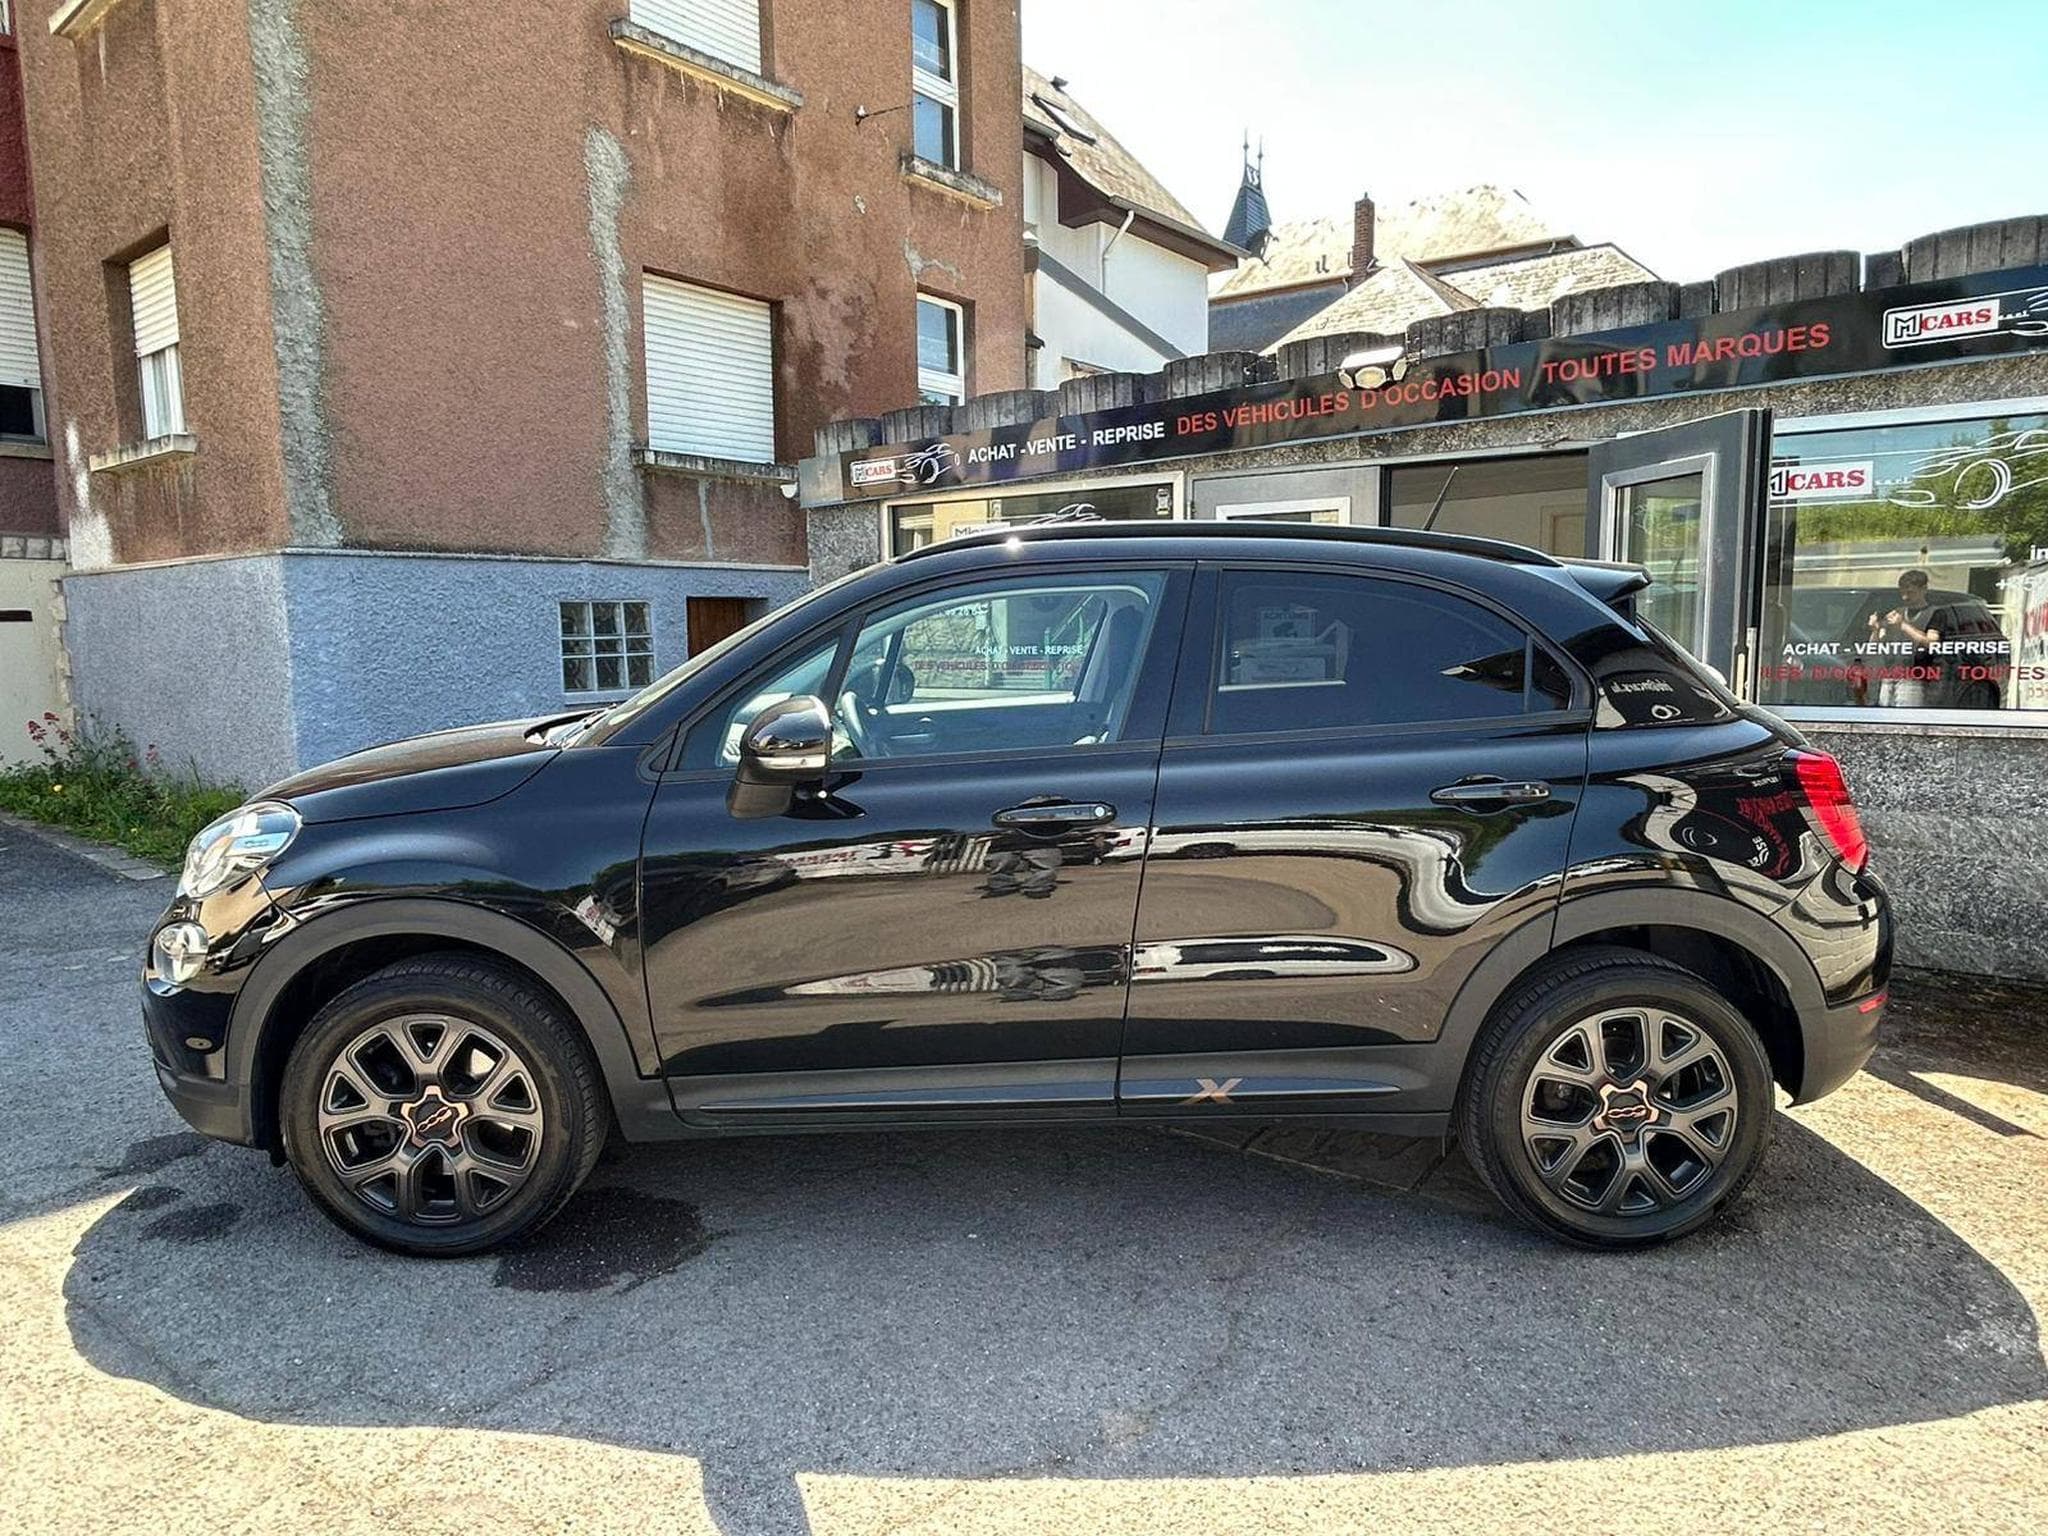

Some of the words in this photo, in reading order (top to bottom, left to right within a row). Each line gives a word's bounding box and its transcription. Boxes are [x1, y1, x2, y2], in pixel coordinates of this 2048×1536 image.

[968, 445, 1017, 465] ACHAT
[1027, 435, 1076, 456] VENTE
[1093, 422, 1166, 446] REPRISE
[1177, 410, 1218, 436] DES
[1224, 391, 1350, 428] VÉHICULES
[1361, 368, 1520, 411] D'OCCASION
[1542, 346, 1656, 385] TOUTES
[1666, 322, 1831, 367] MARQUES
[1010, 646, 1038, 655] VENTE
[1783, 643, 1840, 655] ACHAT
[1855, 641, 1913, 655] VENTE
[1929, 639, 2010, 655] REPRISE
